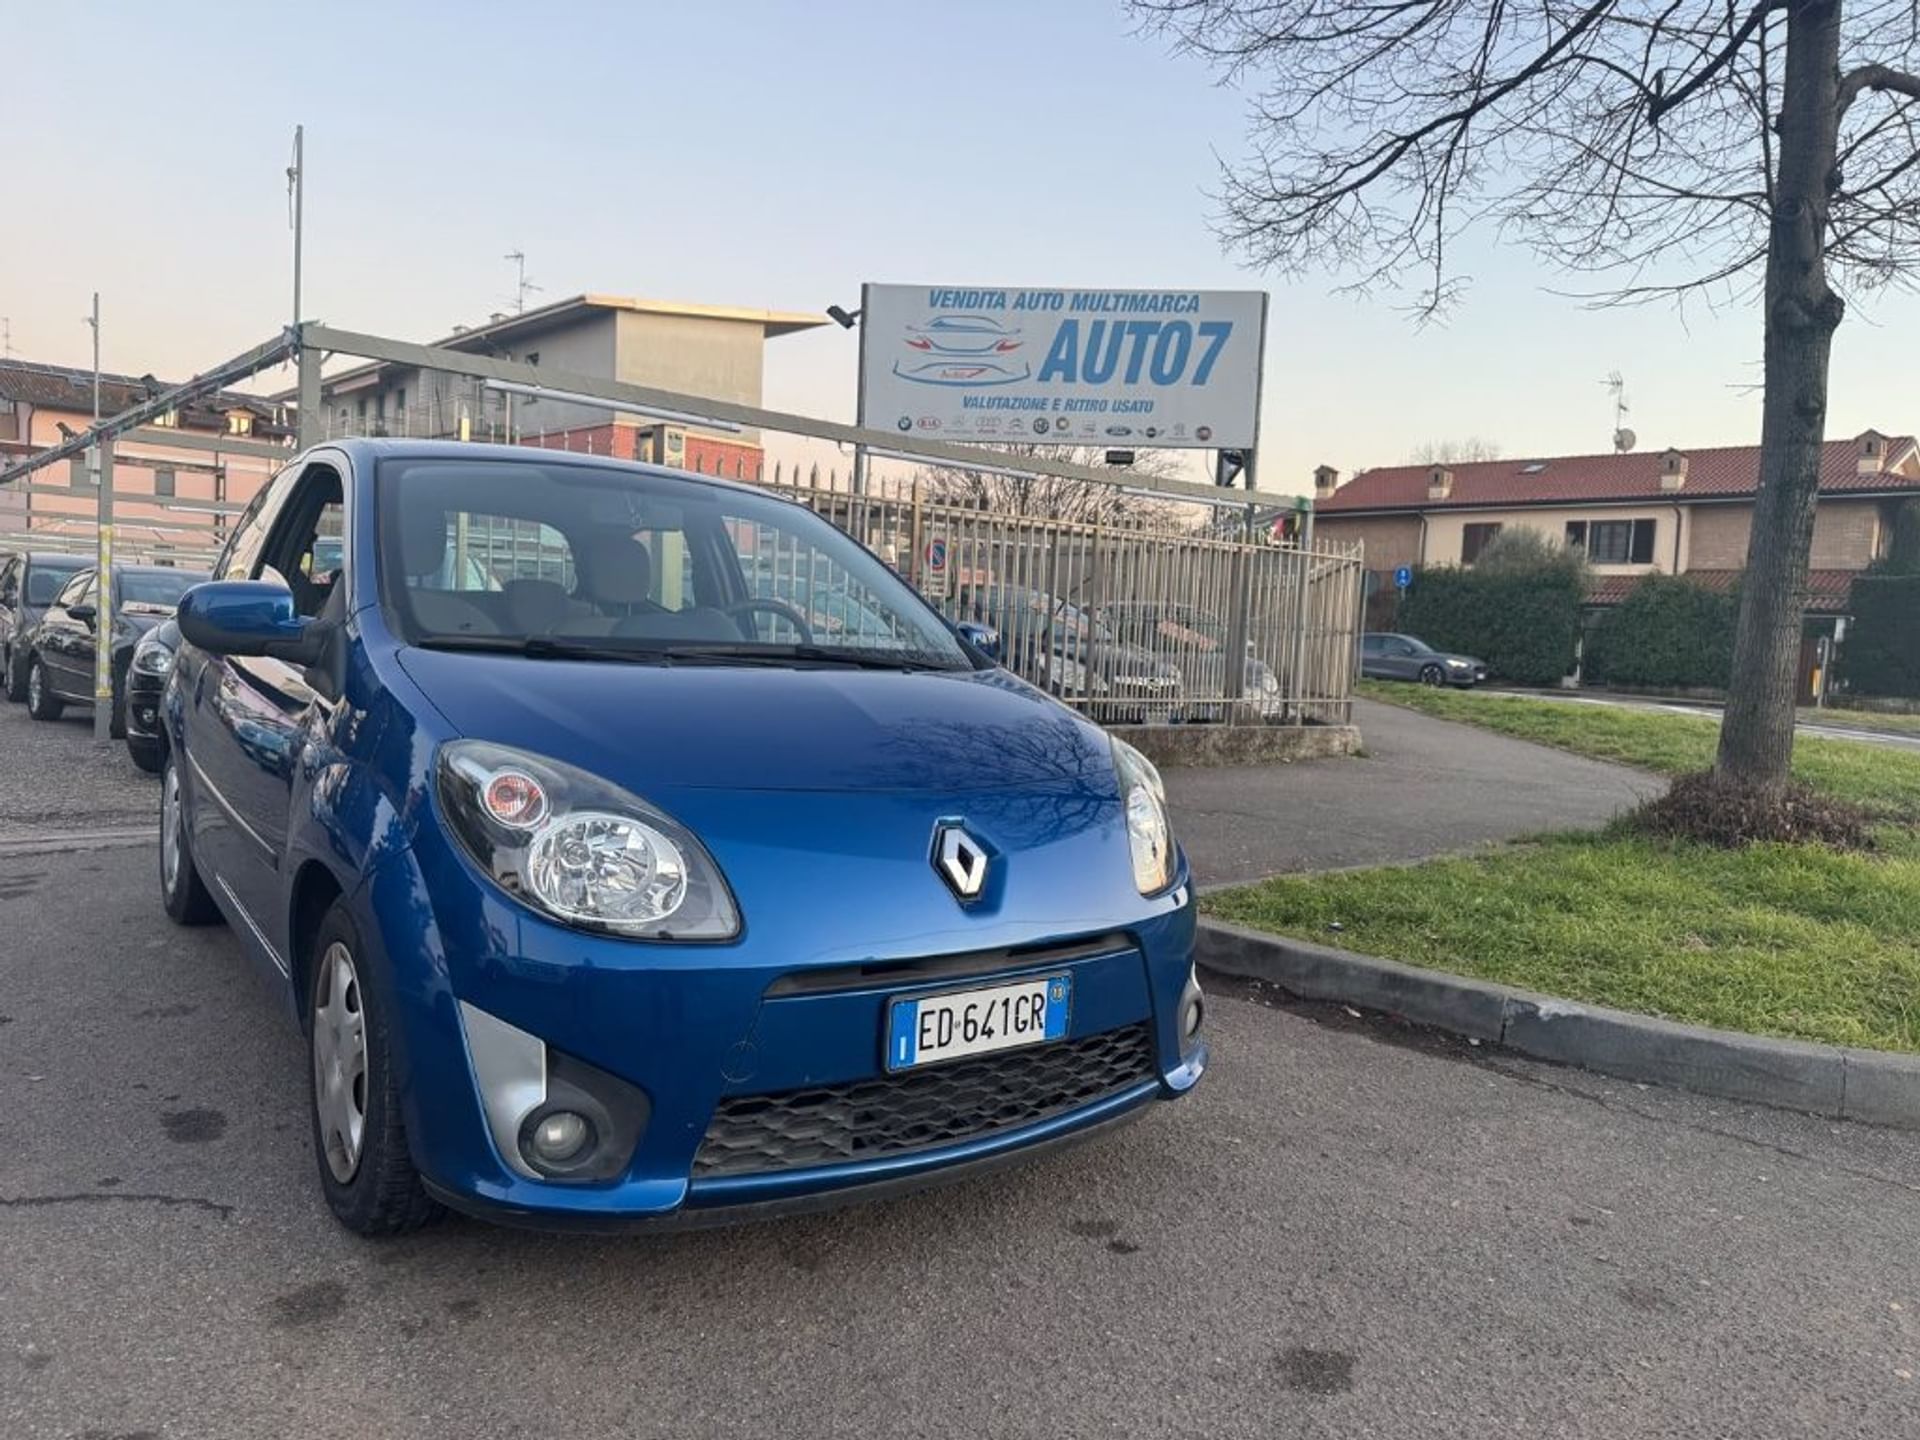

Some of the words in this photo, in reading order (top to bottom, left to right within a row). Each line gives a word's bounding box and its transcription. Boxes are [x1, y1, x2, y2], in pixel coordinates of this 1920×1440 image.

[929, 289, 1006, 309] VENDITA
[1013, 291, 1064, 311] AUTO
[1068, 292, 1200, 313] MULTIMARCA
[1037, 318, 1233, 386] AUTO7
[963, 395, 1047, 411] VALUTAZIONE
[1052, 397, 1061, 411] E
[1064, 398, 1107, 413] RITIRO
[1112, 400, 1154, 414] USATO
